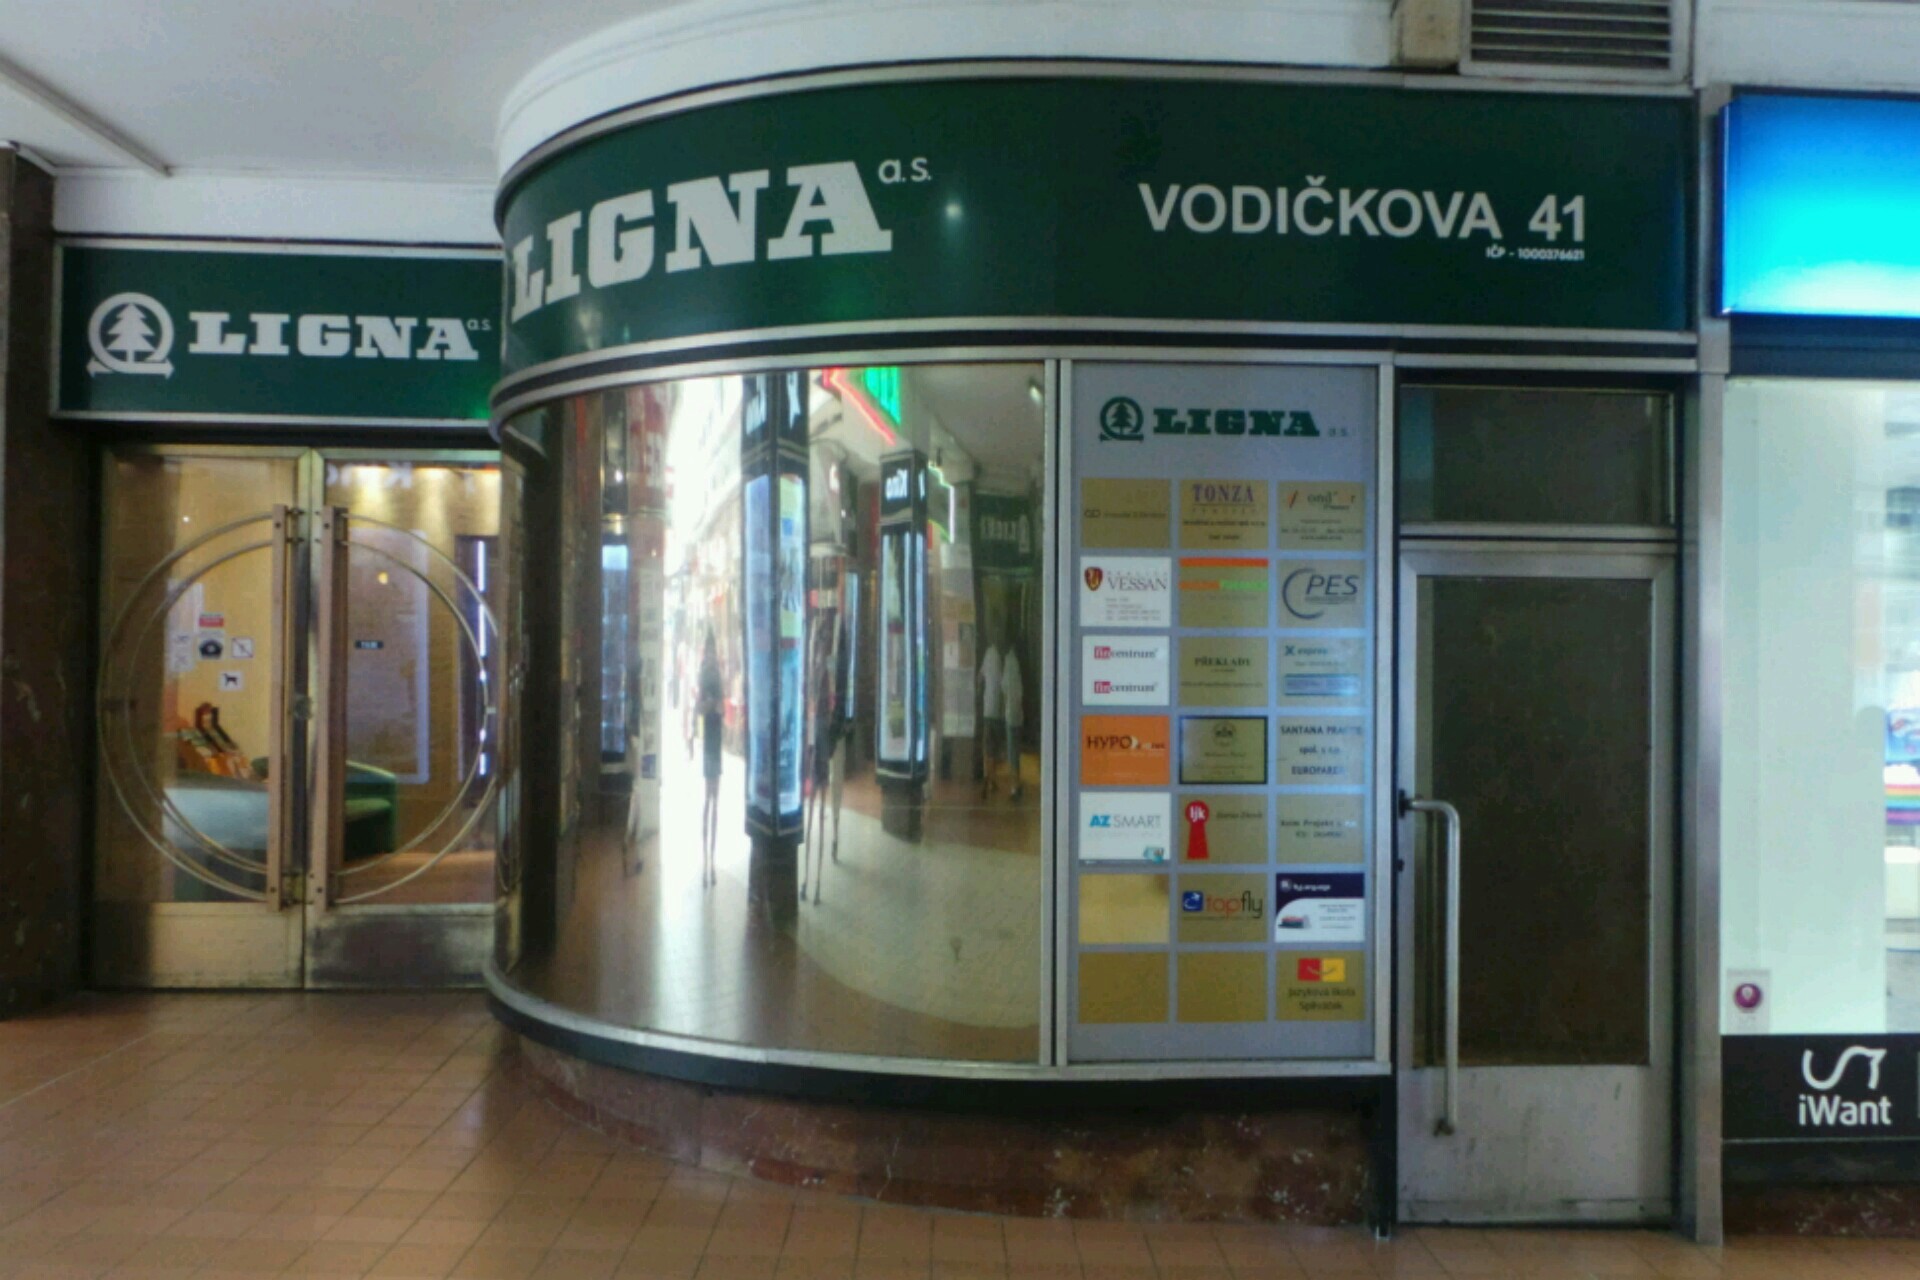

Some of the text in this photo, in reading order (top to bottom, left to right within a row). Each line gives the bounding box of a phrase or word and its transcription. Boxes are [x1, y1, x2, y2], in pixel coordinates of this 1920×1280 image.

[1138, 175, 1586, 242] VODIČKOVA 41
[510, 156, 932, 325] LIGNA a.s.
[188, 311, 479, 361] LIGNA
[1152, 407, 1321, 438] LIGNA
[1192, 484, 1255, 503] TONZA
[1107, 576, 1168, 591] VESSAN
[1089, 814, 1162, 828] AZ SMART
[1798, 1095, 1892, 1127] iWant
